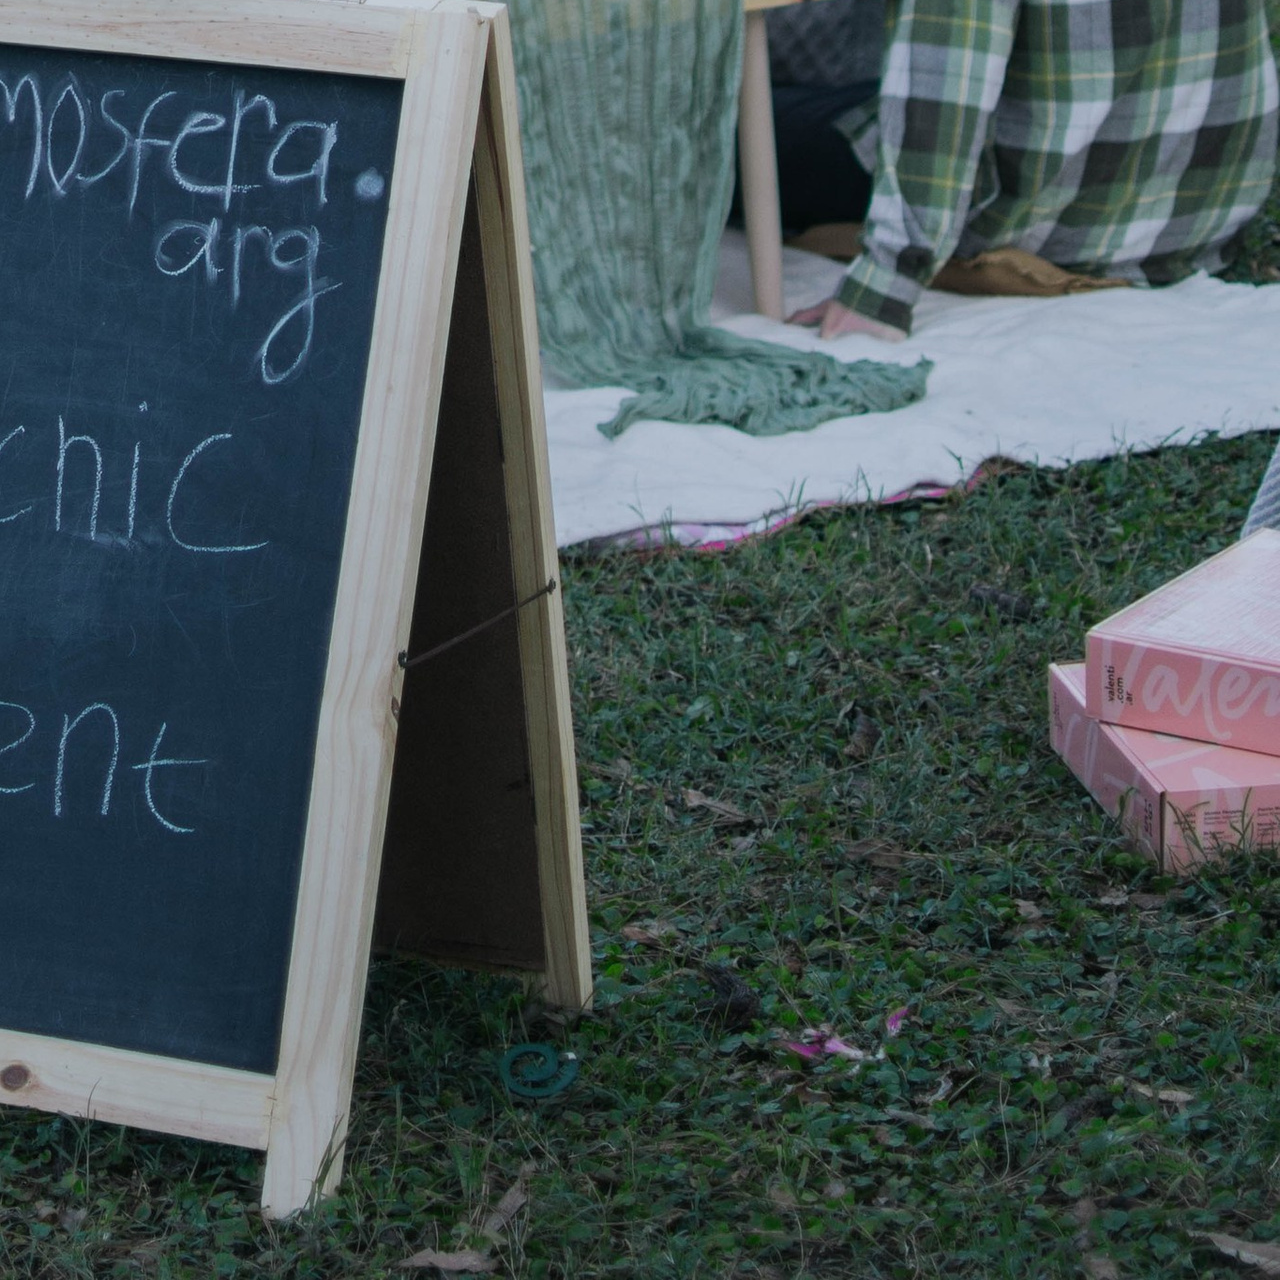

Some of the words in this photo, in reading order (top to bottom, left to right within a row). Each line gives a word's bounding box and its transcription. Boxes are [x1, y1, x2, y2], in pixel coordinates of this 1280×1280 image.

[154, 216, 343, 384] arg
[1104, 664, 1115, 703] valenti
[1116, 677, 1124, 704] .com
